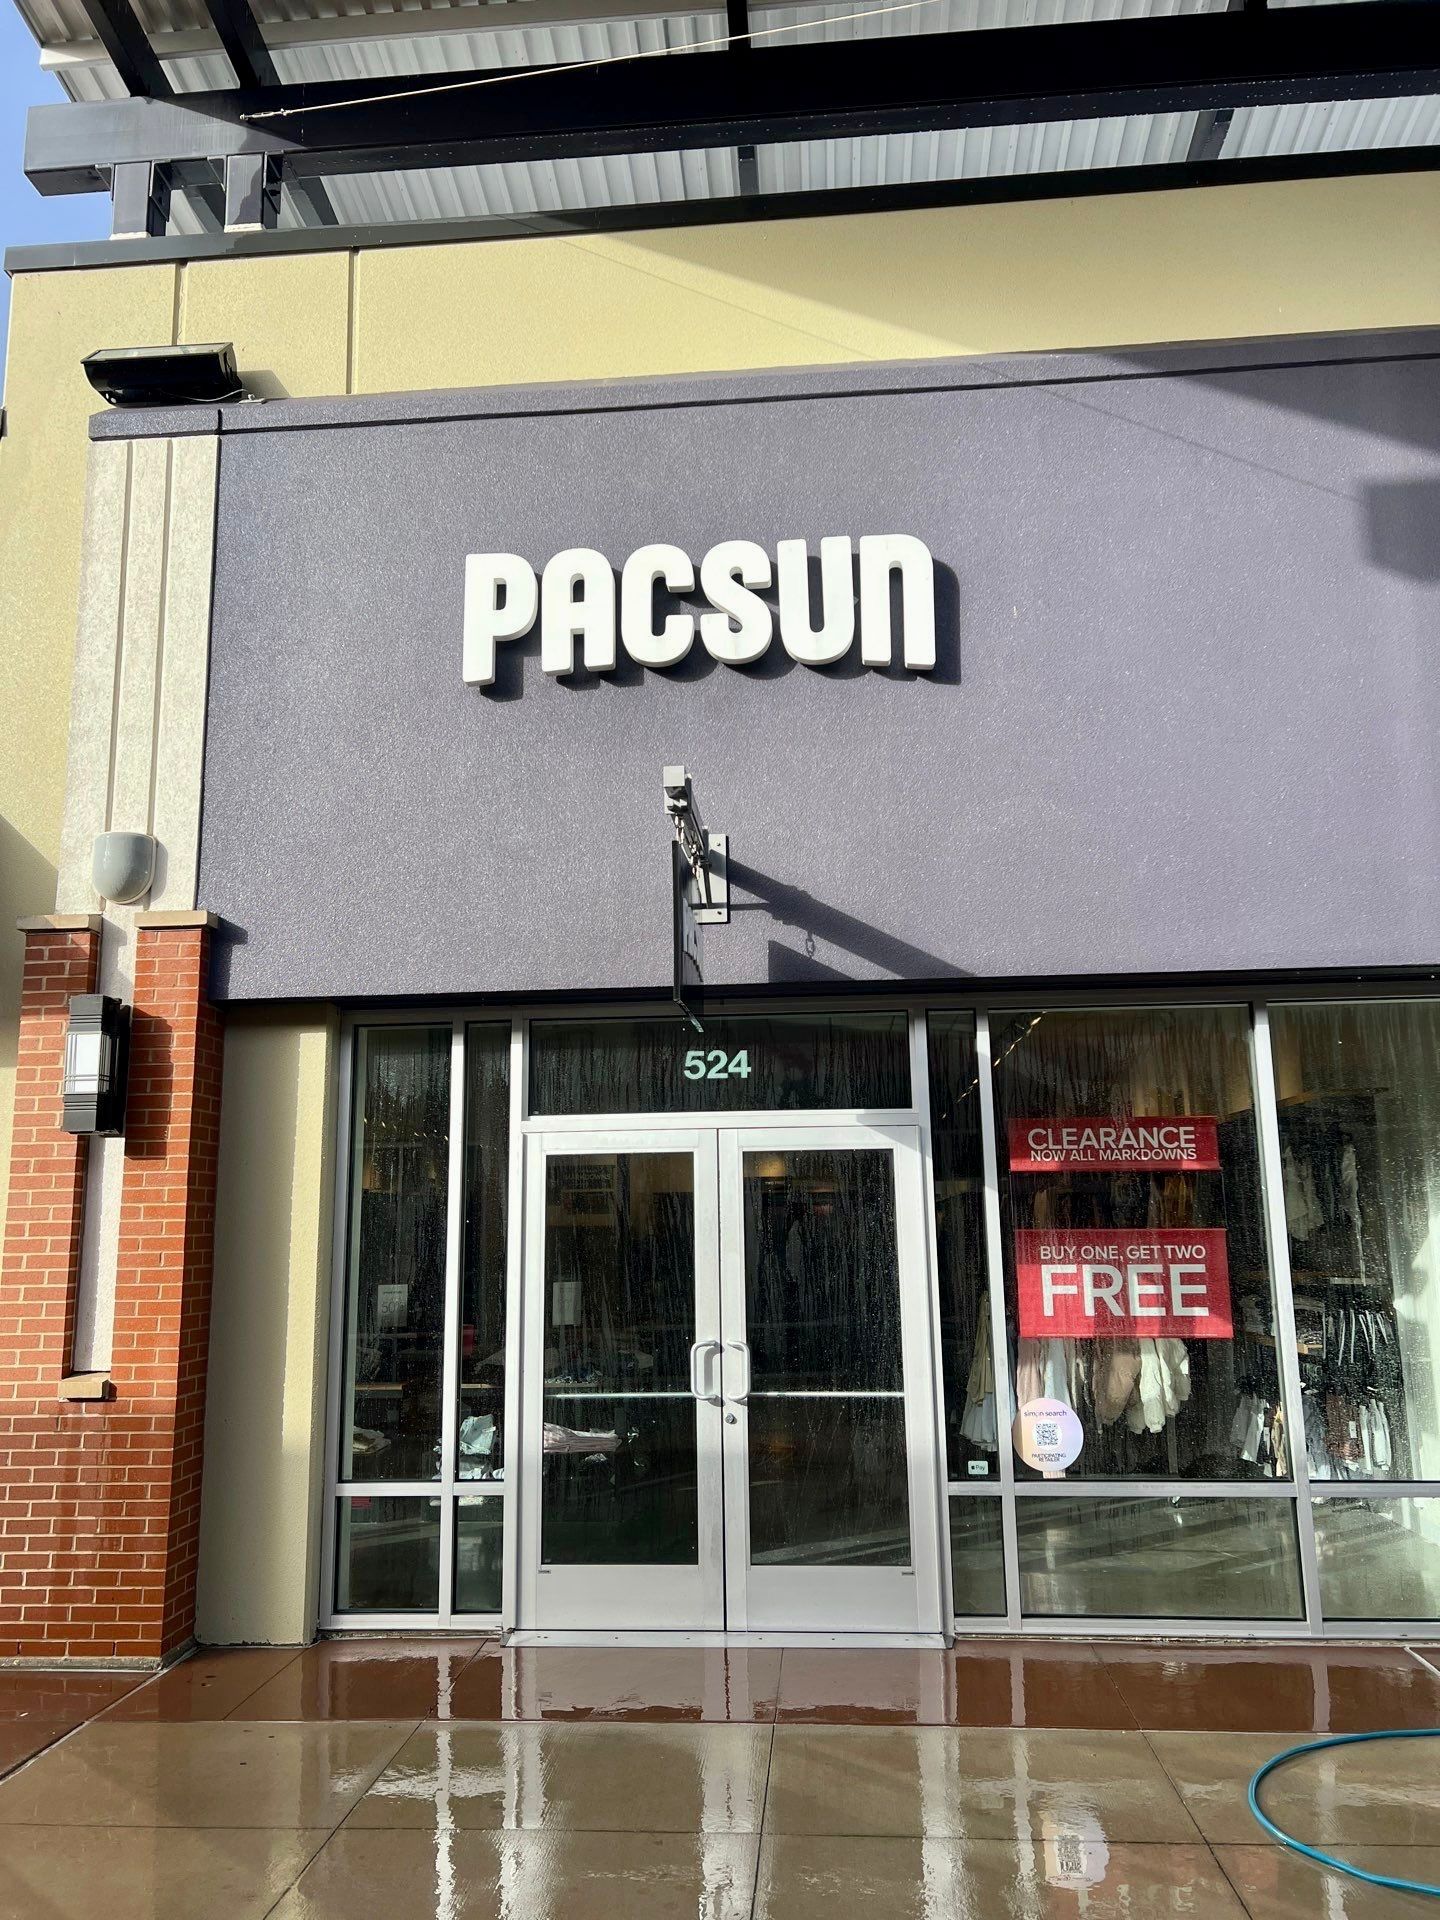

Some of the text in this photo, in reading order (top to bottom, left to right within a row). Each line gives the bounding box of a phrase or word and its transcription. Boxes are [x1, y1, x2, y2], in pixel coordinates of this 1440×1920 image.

[462, 533, 936, 688] PACSUN
[683, 1049, 752, 1080] 524
[1027, 1126, 1196, 1150] CLEARANCE
[1030, 1148, 1197, 1162] NOW ALL MARKDOWNS
[1040, 1244, 1206, 1262] BUY ONE, GET TWO
[1041, 1263, 1210, 1317] FREE
